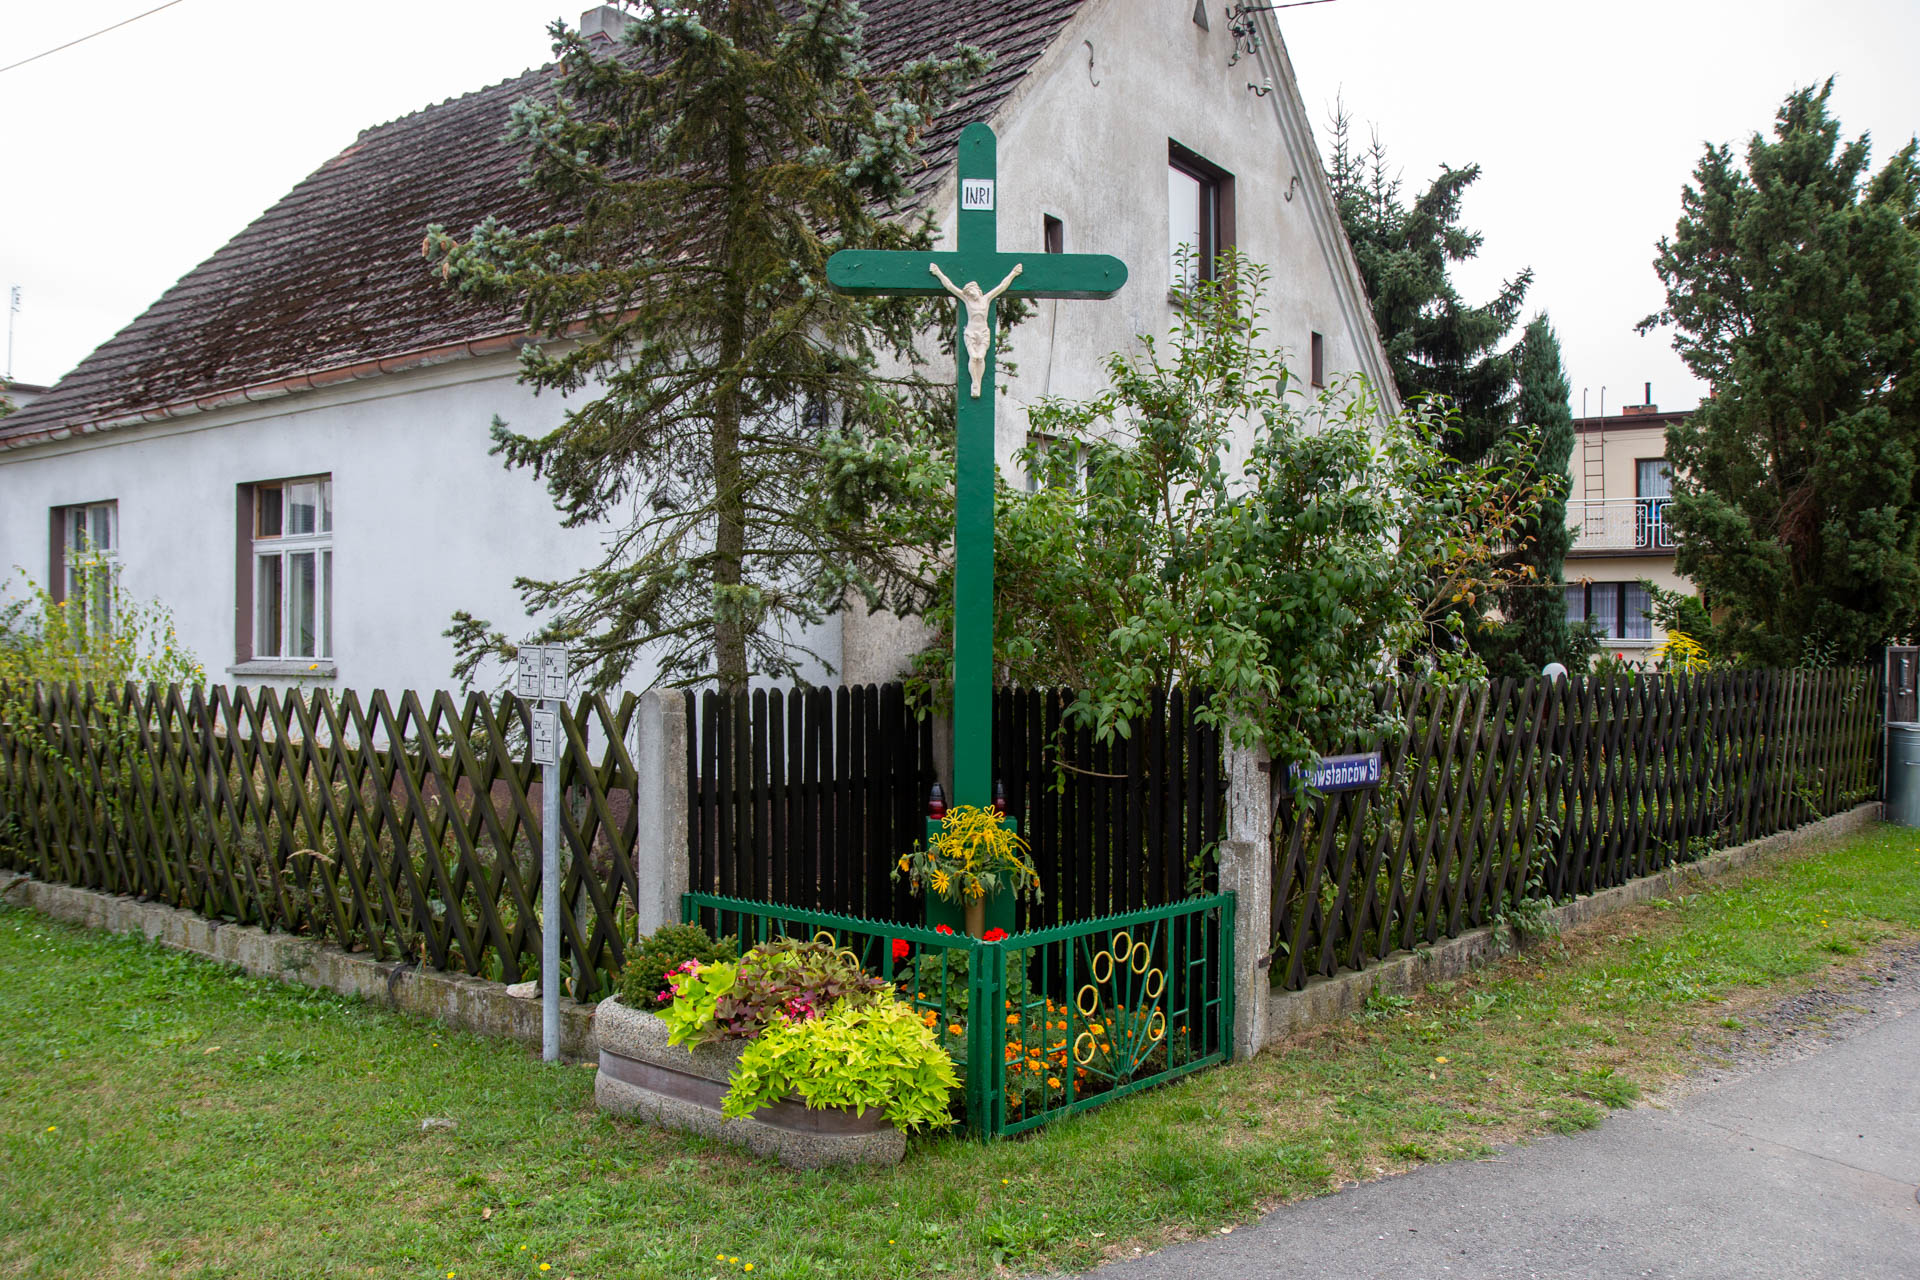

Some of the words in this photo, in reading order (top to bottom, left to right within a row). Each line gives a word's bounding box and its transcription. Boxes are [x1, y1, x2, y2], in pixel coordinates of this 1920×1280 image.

[965, 186, 990, 205] INRI
[520, 655, 529, 665] ZK
[545, 656, 554, 666] ZK
[534, 720, 542, 730] ZK
